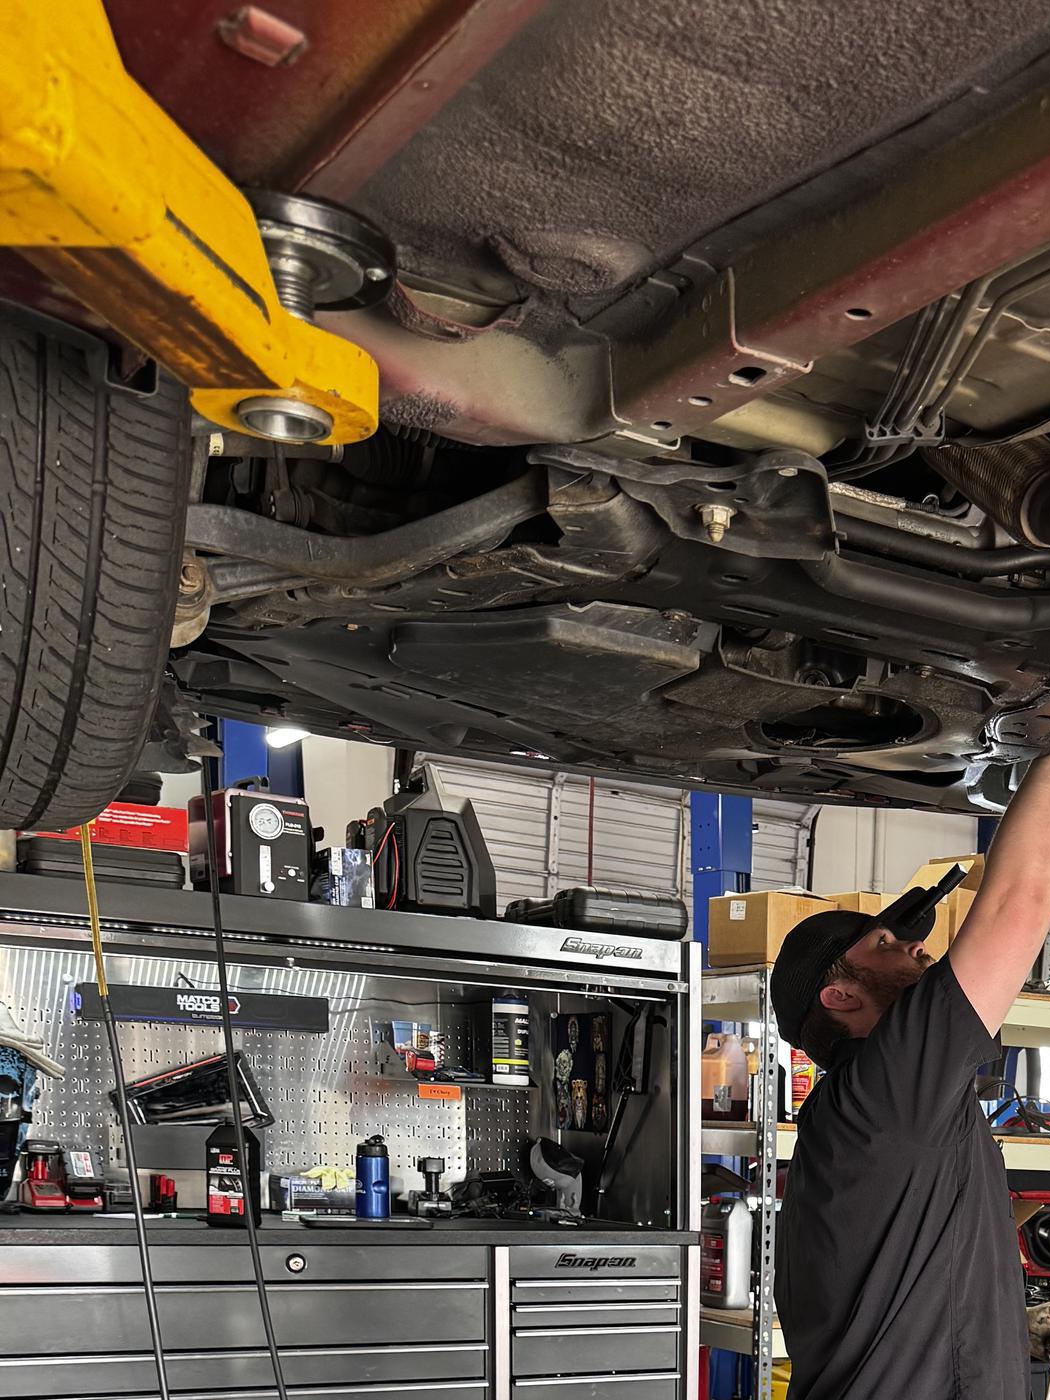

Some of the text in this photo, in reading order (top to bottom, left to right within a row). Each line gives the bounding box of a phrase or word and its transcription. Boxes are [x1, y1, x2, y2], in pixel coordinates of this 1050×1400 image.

[560, 937, 643, 959] Snap-on
[177, 994, 220, 1005] MATCO
[178, 1002, 220, 1013] TOOLS
[555, 1252, 636, 1271] Snap-on
